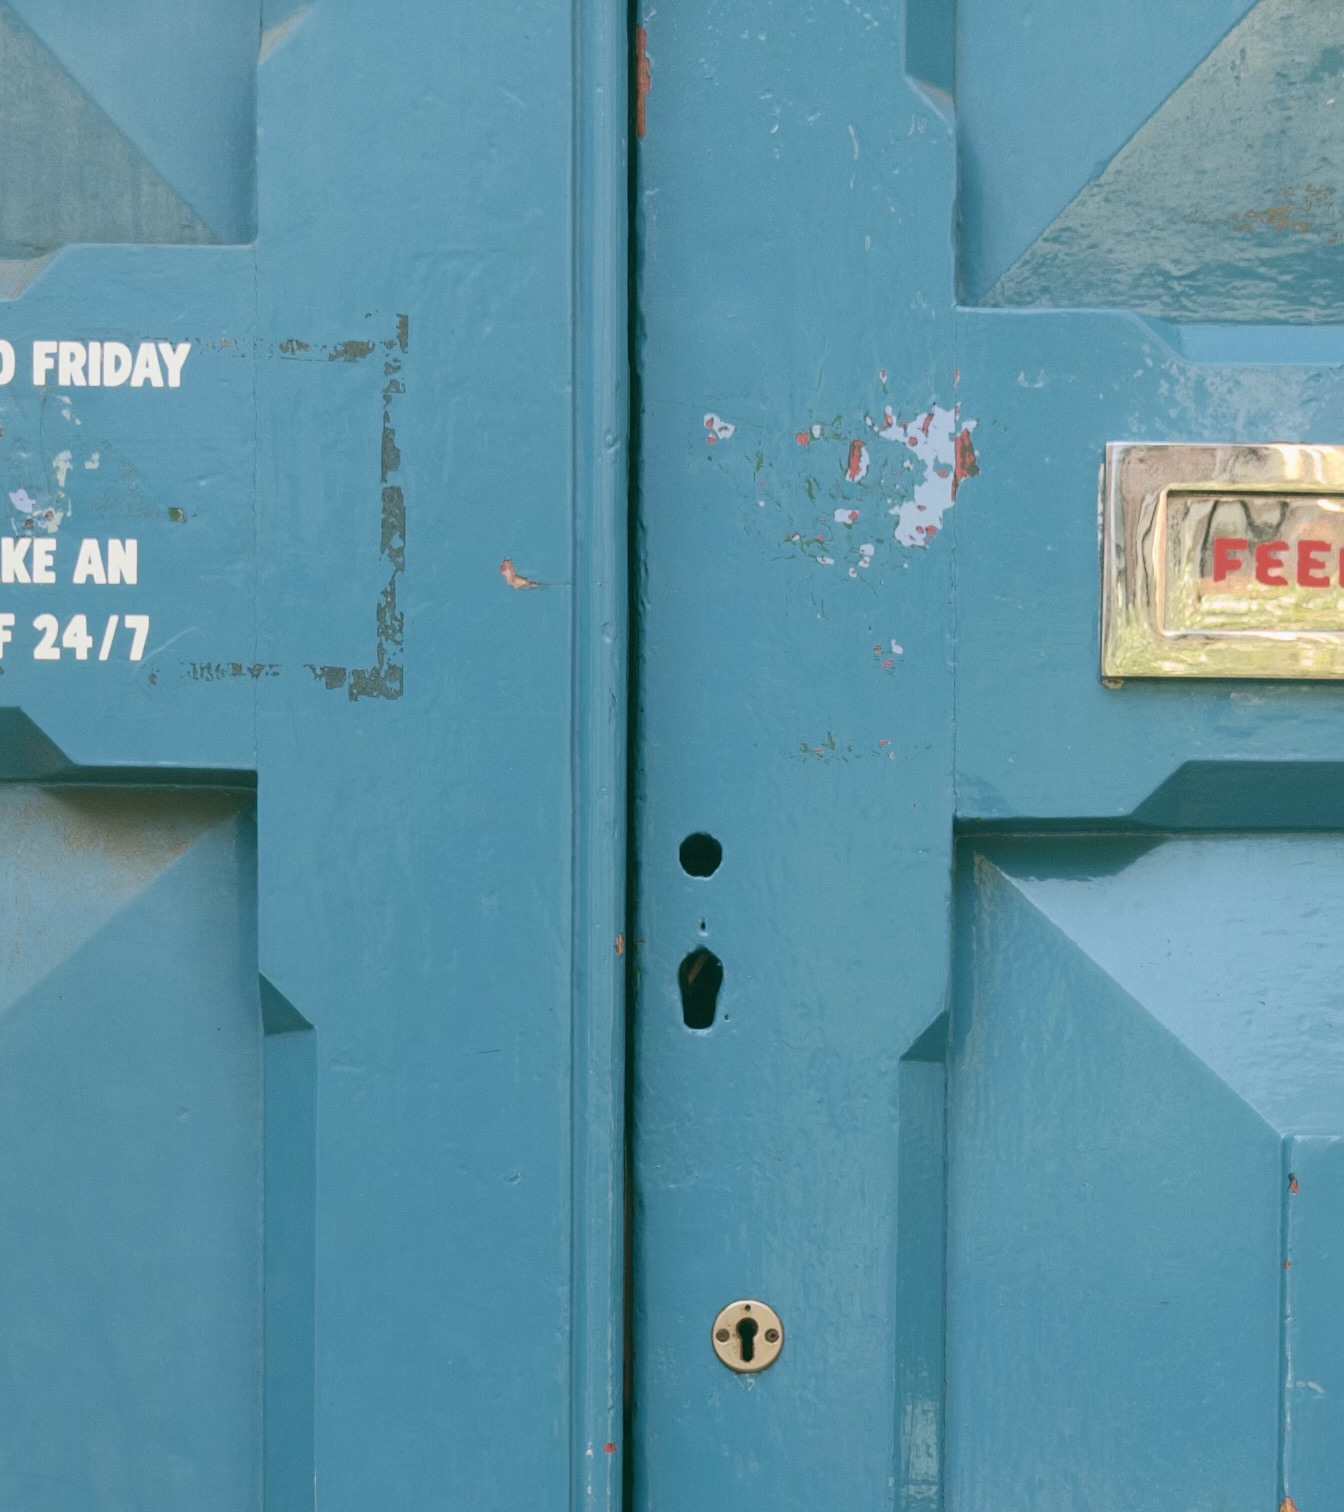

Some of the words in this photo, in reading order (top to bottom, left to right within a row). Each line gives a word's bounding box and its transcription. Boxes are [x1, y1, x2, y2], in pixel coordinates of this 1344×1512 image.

[32, 341, 192, 388] FRIDAY
[72, 538, 139, 586] AN
[31, 613, 150, 662] 24/7
